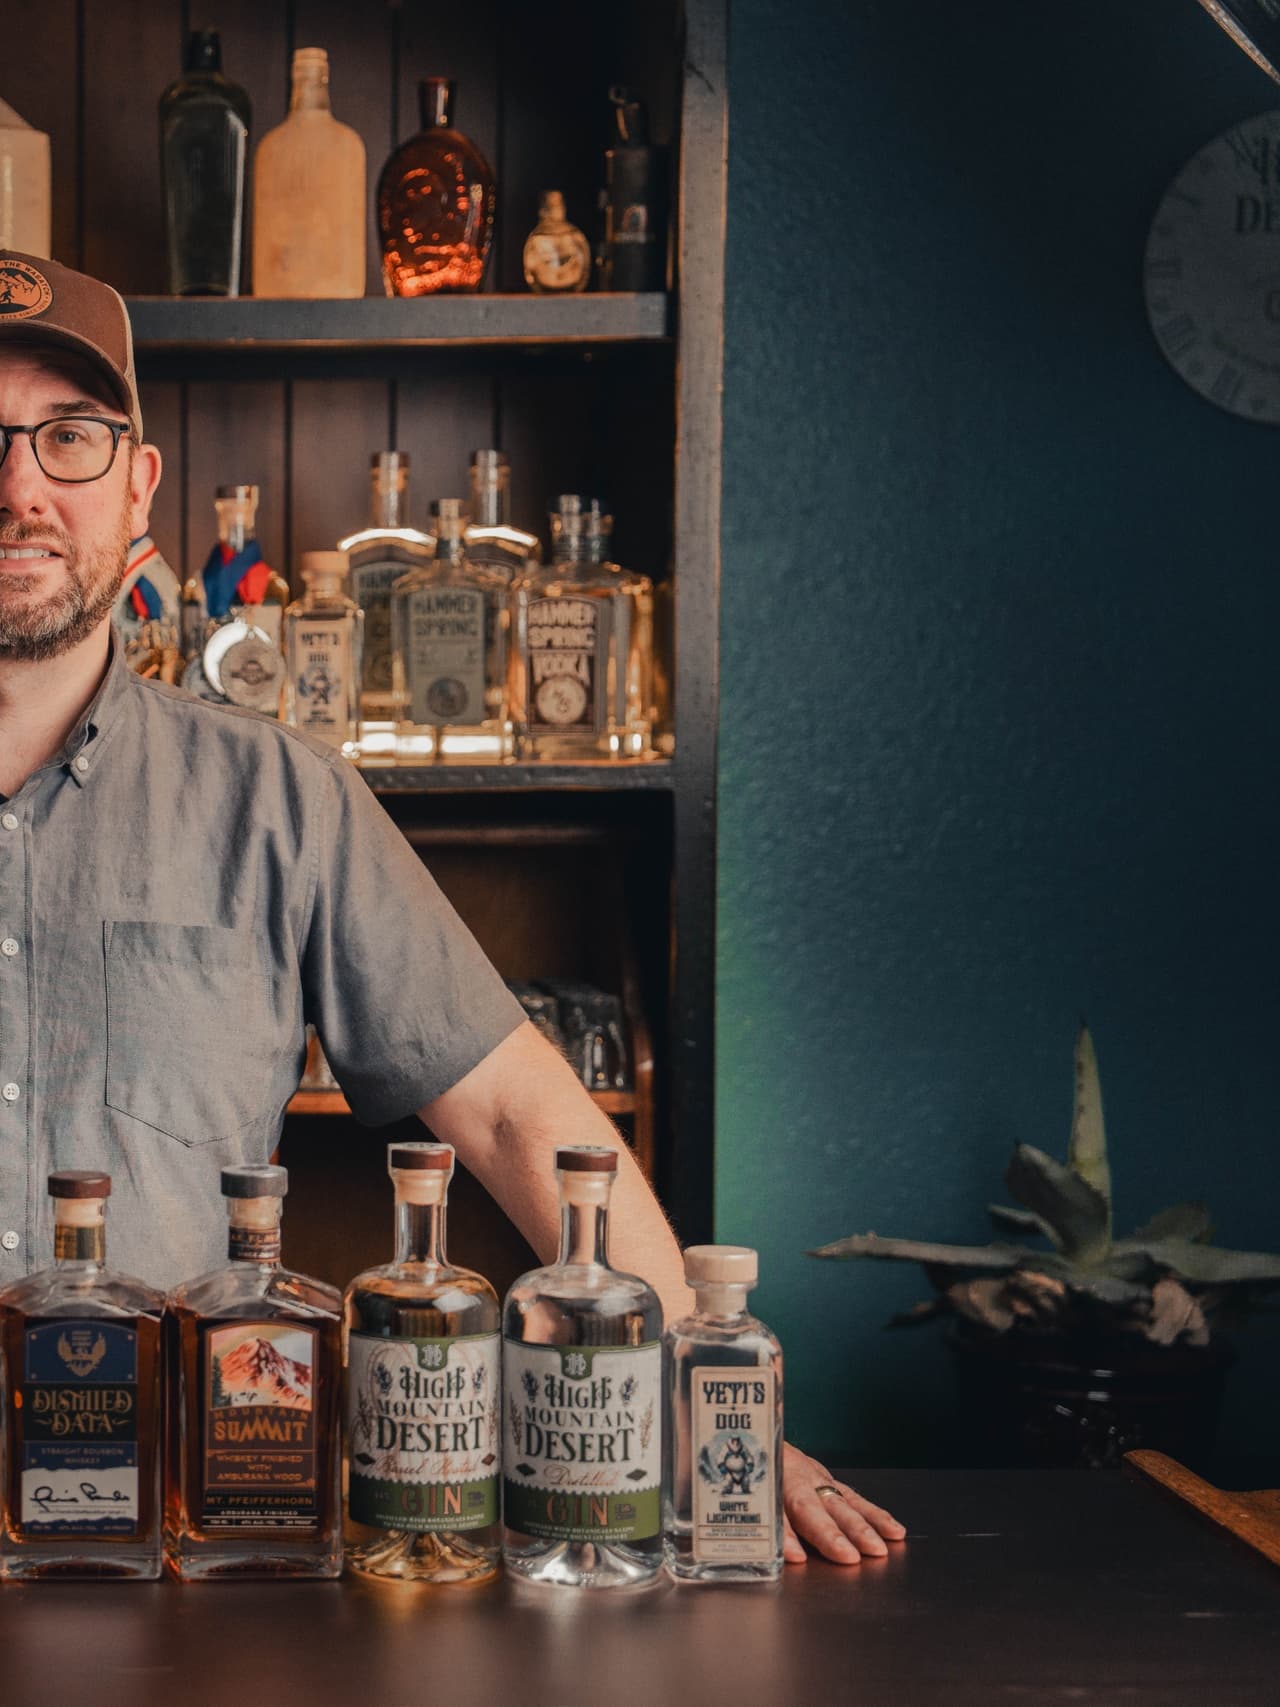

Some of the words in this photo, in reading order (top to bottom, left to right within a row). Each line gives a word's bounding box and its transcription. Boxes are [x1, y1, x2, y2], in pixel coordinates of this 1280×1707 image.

[527, 601, 596, 626] HAMMER
[527, 626, 596, 649] SPRING
[533, 654, 591, 687] VODKA
[399, 1366, 466, 1400] HIGH
[544, 1373, 612, 1409] HIGH
[703, 1381, 766, 1405] YETI'S
[32, 1388, 133, 1413] DISTILLED
[377, 1400, 485, 1418] MOUNTAIN
[51, 1411, 114, 1436] DATA
[214, 1416, 308, 1442] SUMMIT
[525, 1405, 635, 1428] MOUNTAIN
[715, 1413, 752, 1430] DOG
[377, 1415, 485, 1453] DESERT
[525, 1422, 635, 1463] DESERT
[543, 1464, 619, 1487] Distilled
[401, 1485, 463, 1517] GIN
[546, 1495, 609, 1527] GIN
[719, 1501, 749, 1512] WHITE
